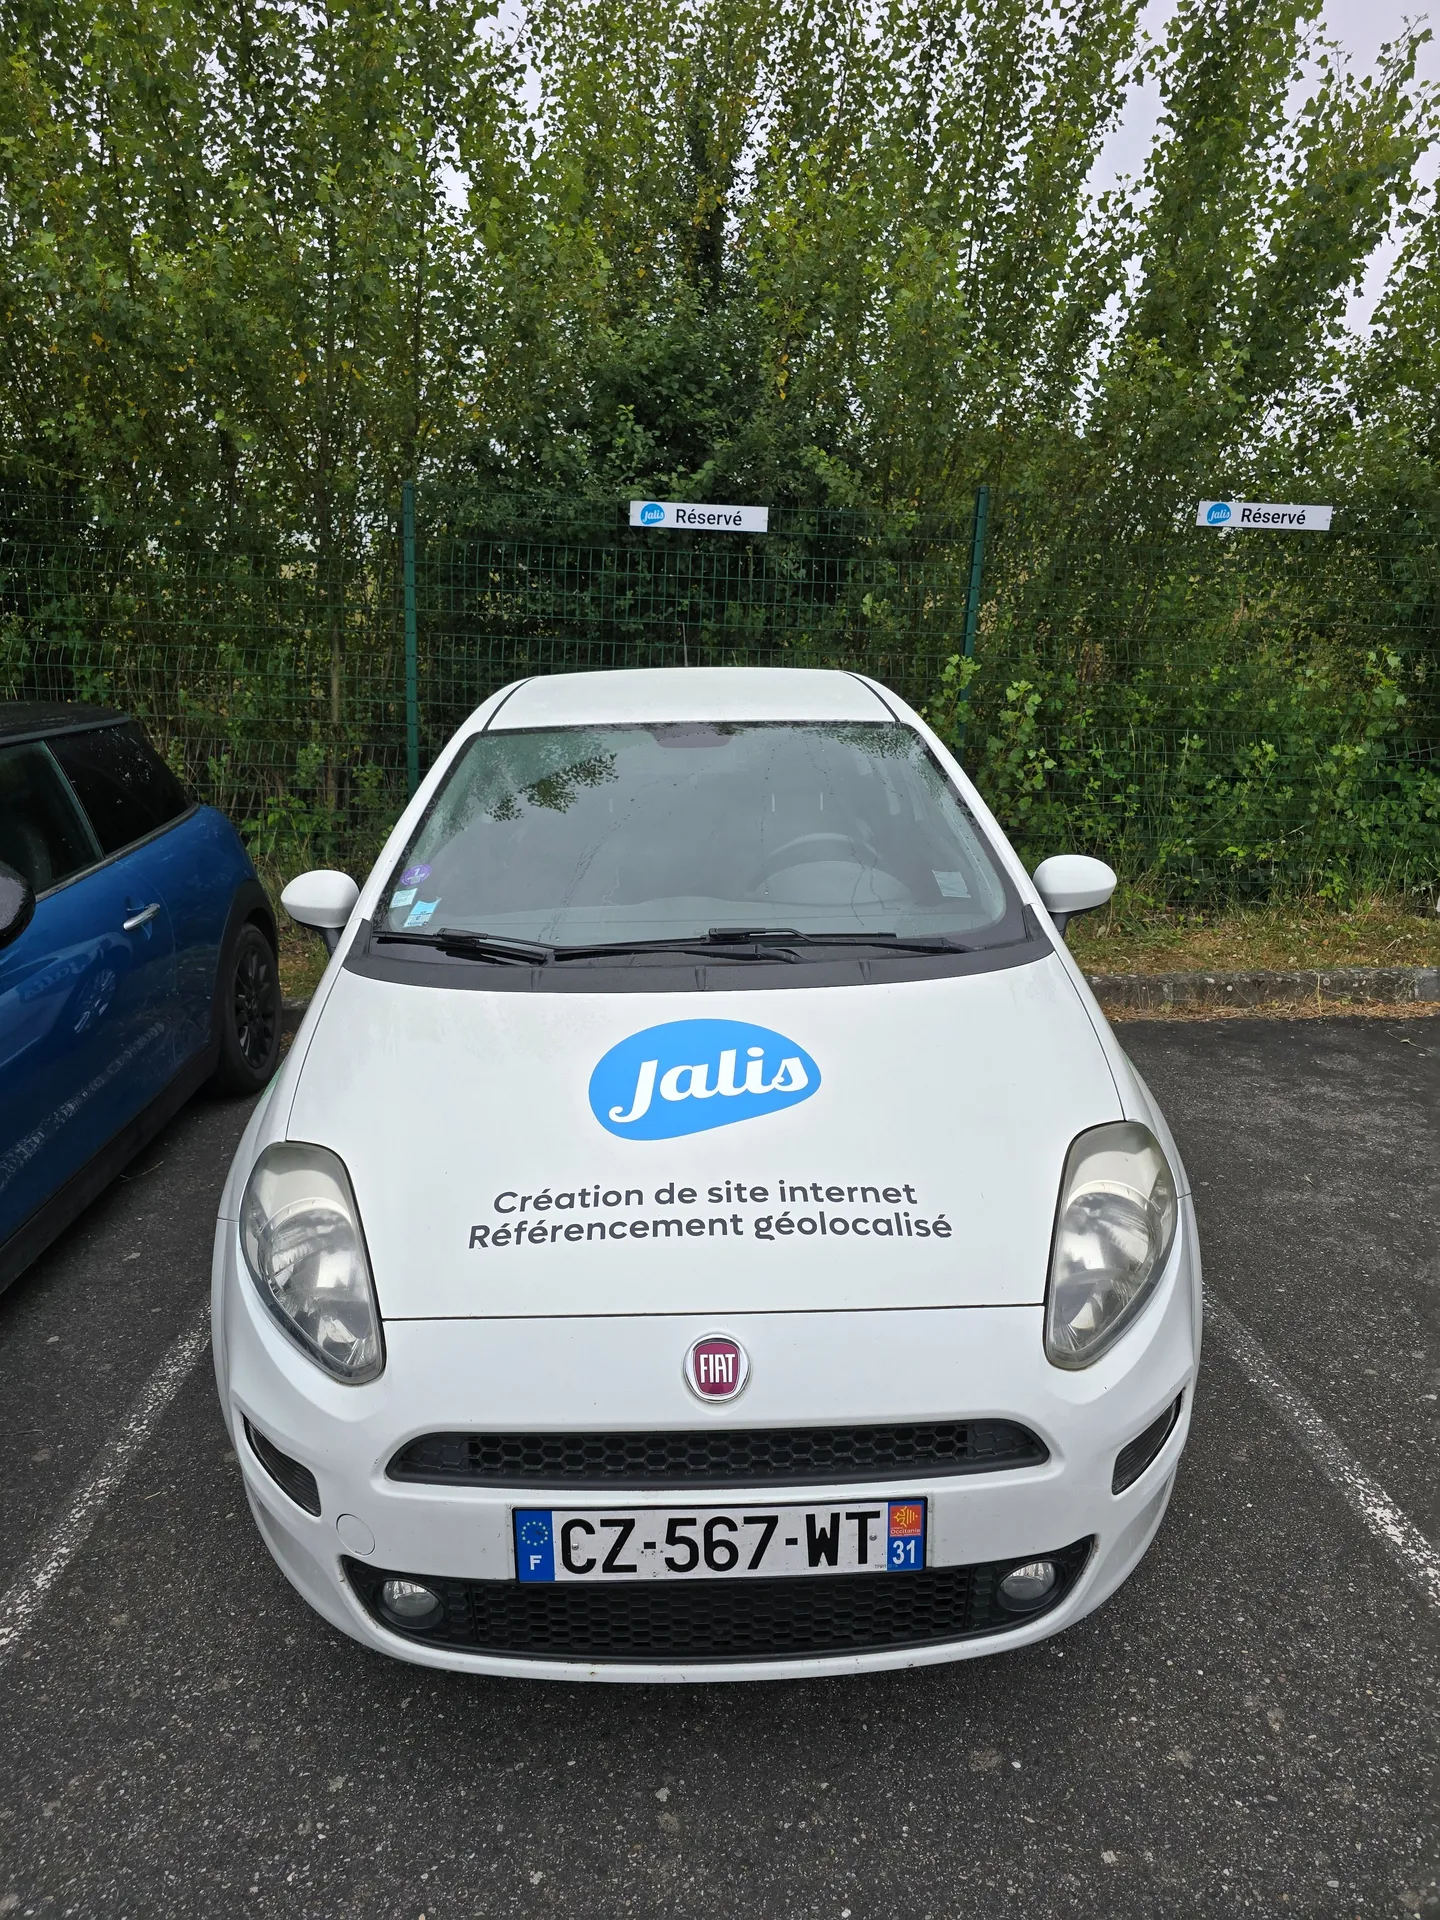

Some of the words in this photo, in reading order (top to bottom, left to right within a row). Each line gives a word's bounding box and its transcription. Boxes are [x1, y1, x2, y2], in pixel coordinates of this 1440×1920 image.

[676, 509, 742, 526] Réservé
[1241, 508, 1306, 525] Réservé
[608, 1047, 809, 1123] Jalis
[493, 1184, 644, 1214] Création
[654, 1182, 698, 1204] de
[707, 1180, 769, 1203] site
[778, 1179, 918, 1204] internet
[468, 1214, 744, 1249] Référencement
[753, 1211, 953, 1241] géolocalisé
[699, 1354, 736, 1384] FIAT
[561, 1510, 881, 1575] CZ-567-WT
[892, 1539, 916, 1565] 31
[529, 1555, 542, 1570] F
